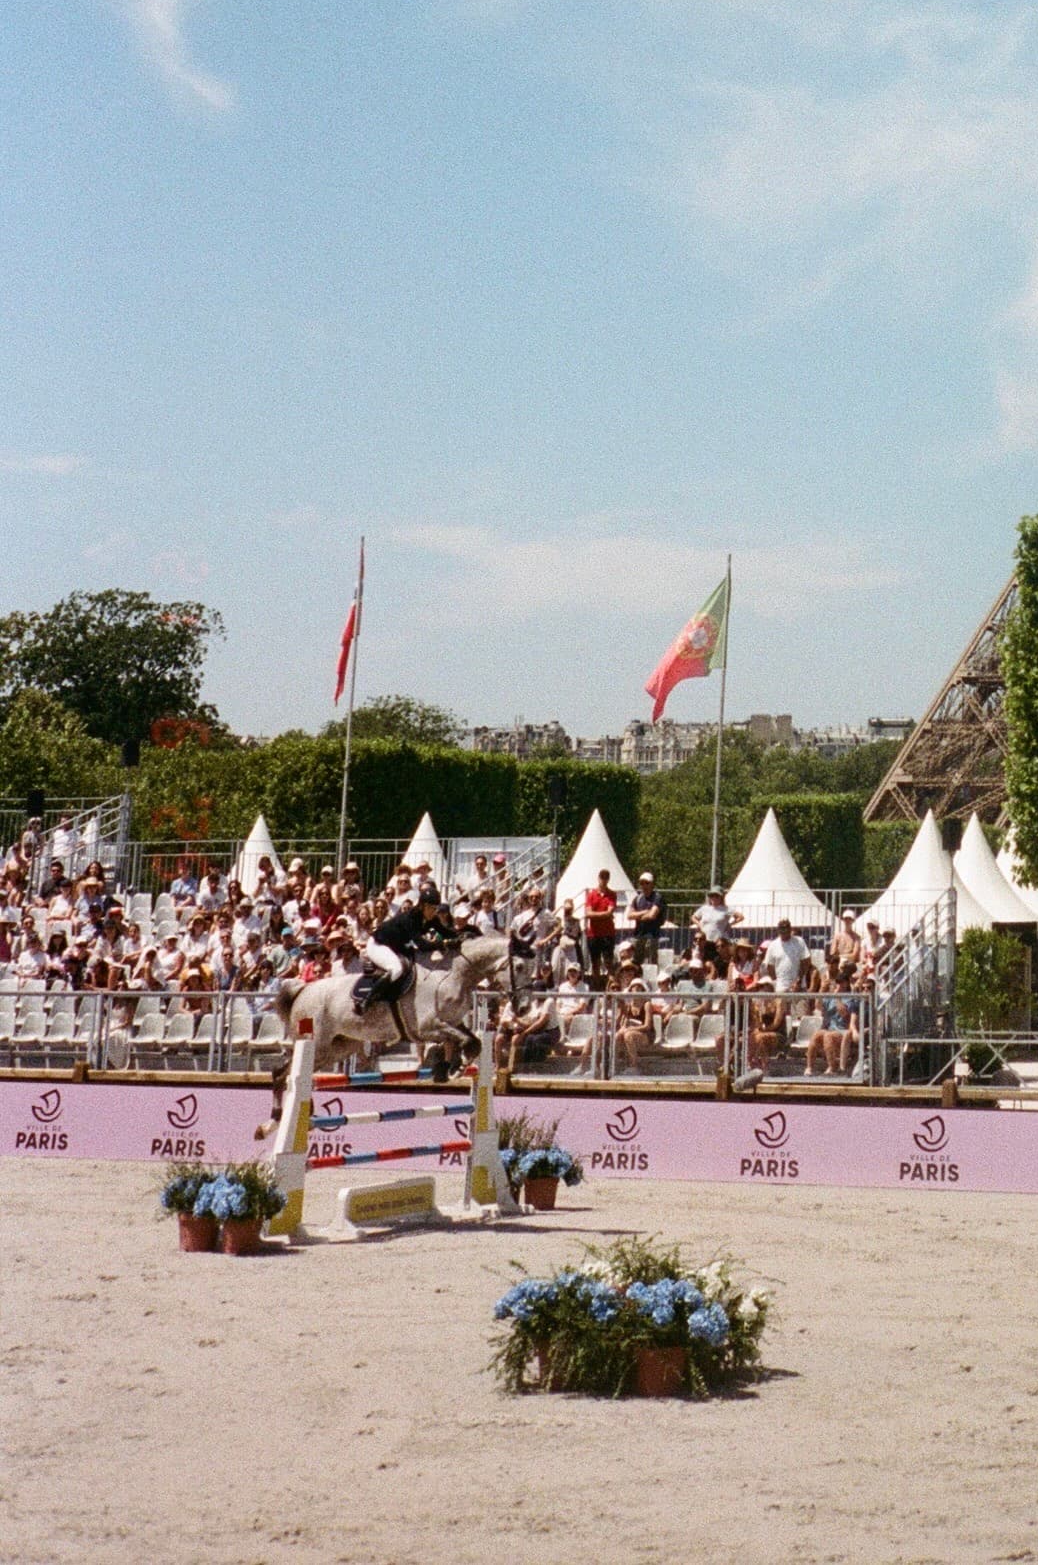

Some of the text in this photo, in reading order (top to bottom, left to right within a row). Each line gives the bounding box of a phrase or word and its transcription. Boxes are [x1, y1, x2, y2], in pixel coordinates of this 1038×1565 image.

[15, 1132, 68, 1150] PARIS
[151, 1138, 205, 1157] PARIS
[308, 1143, 353, 1158] ARIS
[591, 1152, 649, 1170] PARIS
[740, 1159, 799, 1178] PARIS
[899, 1162, 960, 1182] PARIS
